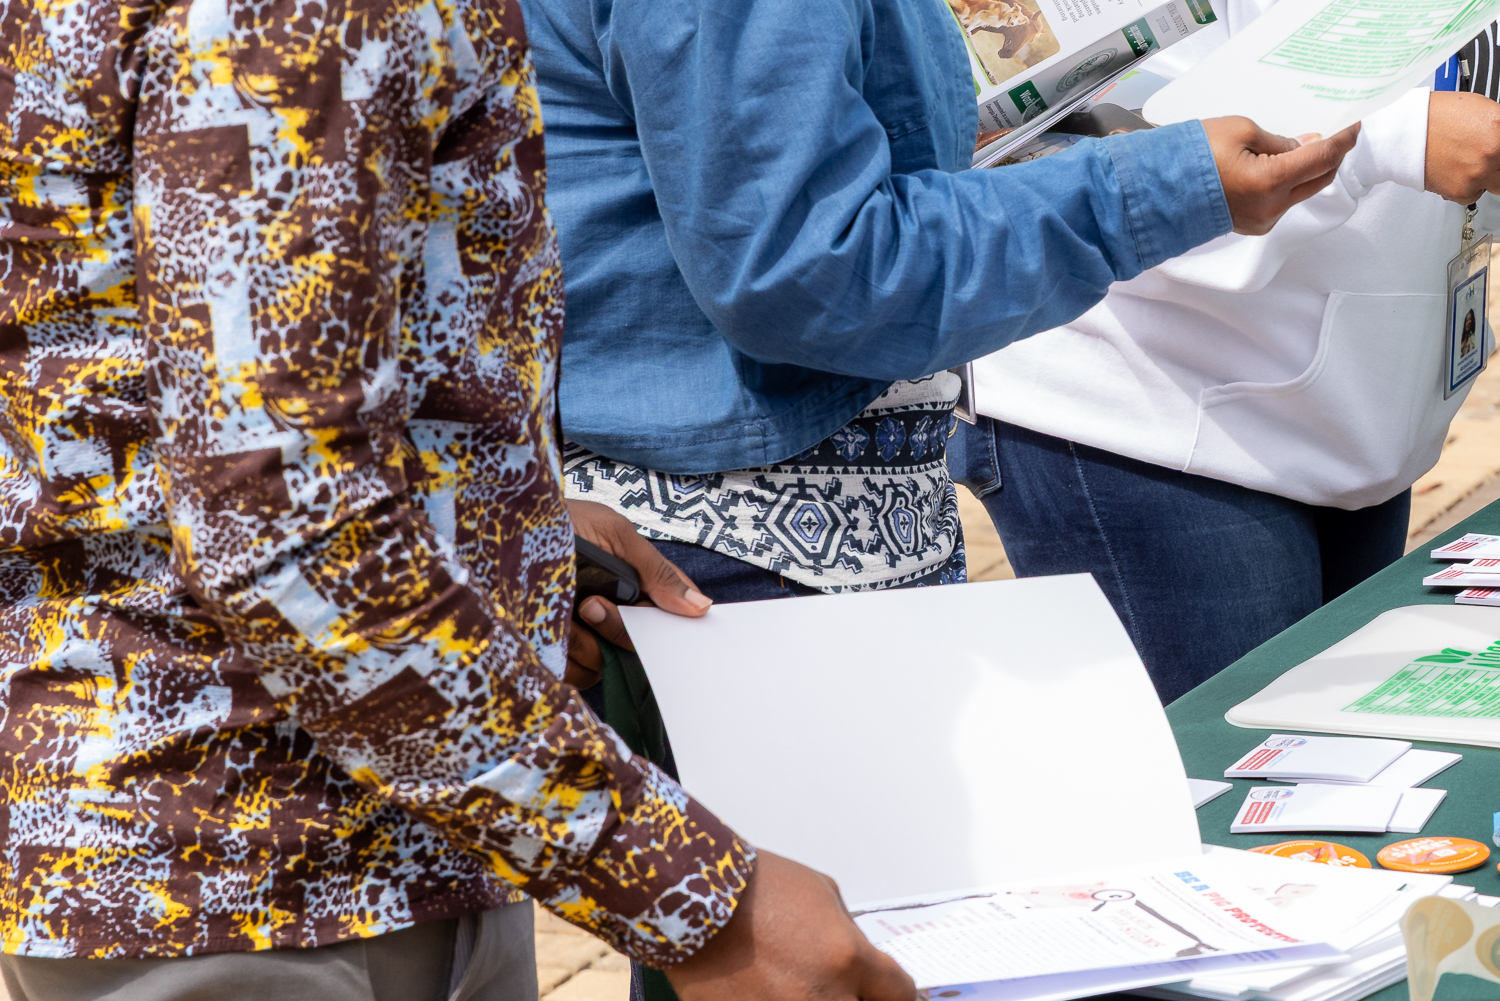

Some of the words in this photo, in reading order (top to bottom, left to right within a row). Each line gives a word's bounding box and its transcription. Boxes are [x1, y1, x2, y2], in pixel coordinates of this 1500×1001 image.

[1068, 10, 1079, 22] and
[1391, 839, 1453, 858] SWEET
[1173, 871, 1201, 884] BE
[1202, 892, 1232, 907] PIG
